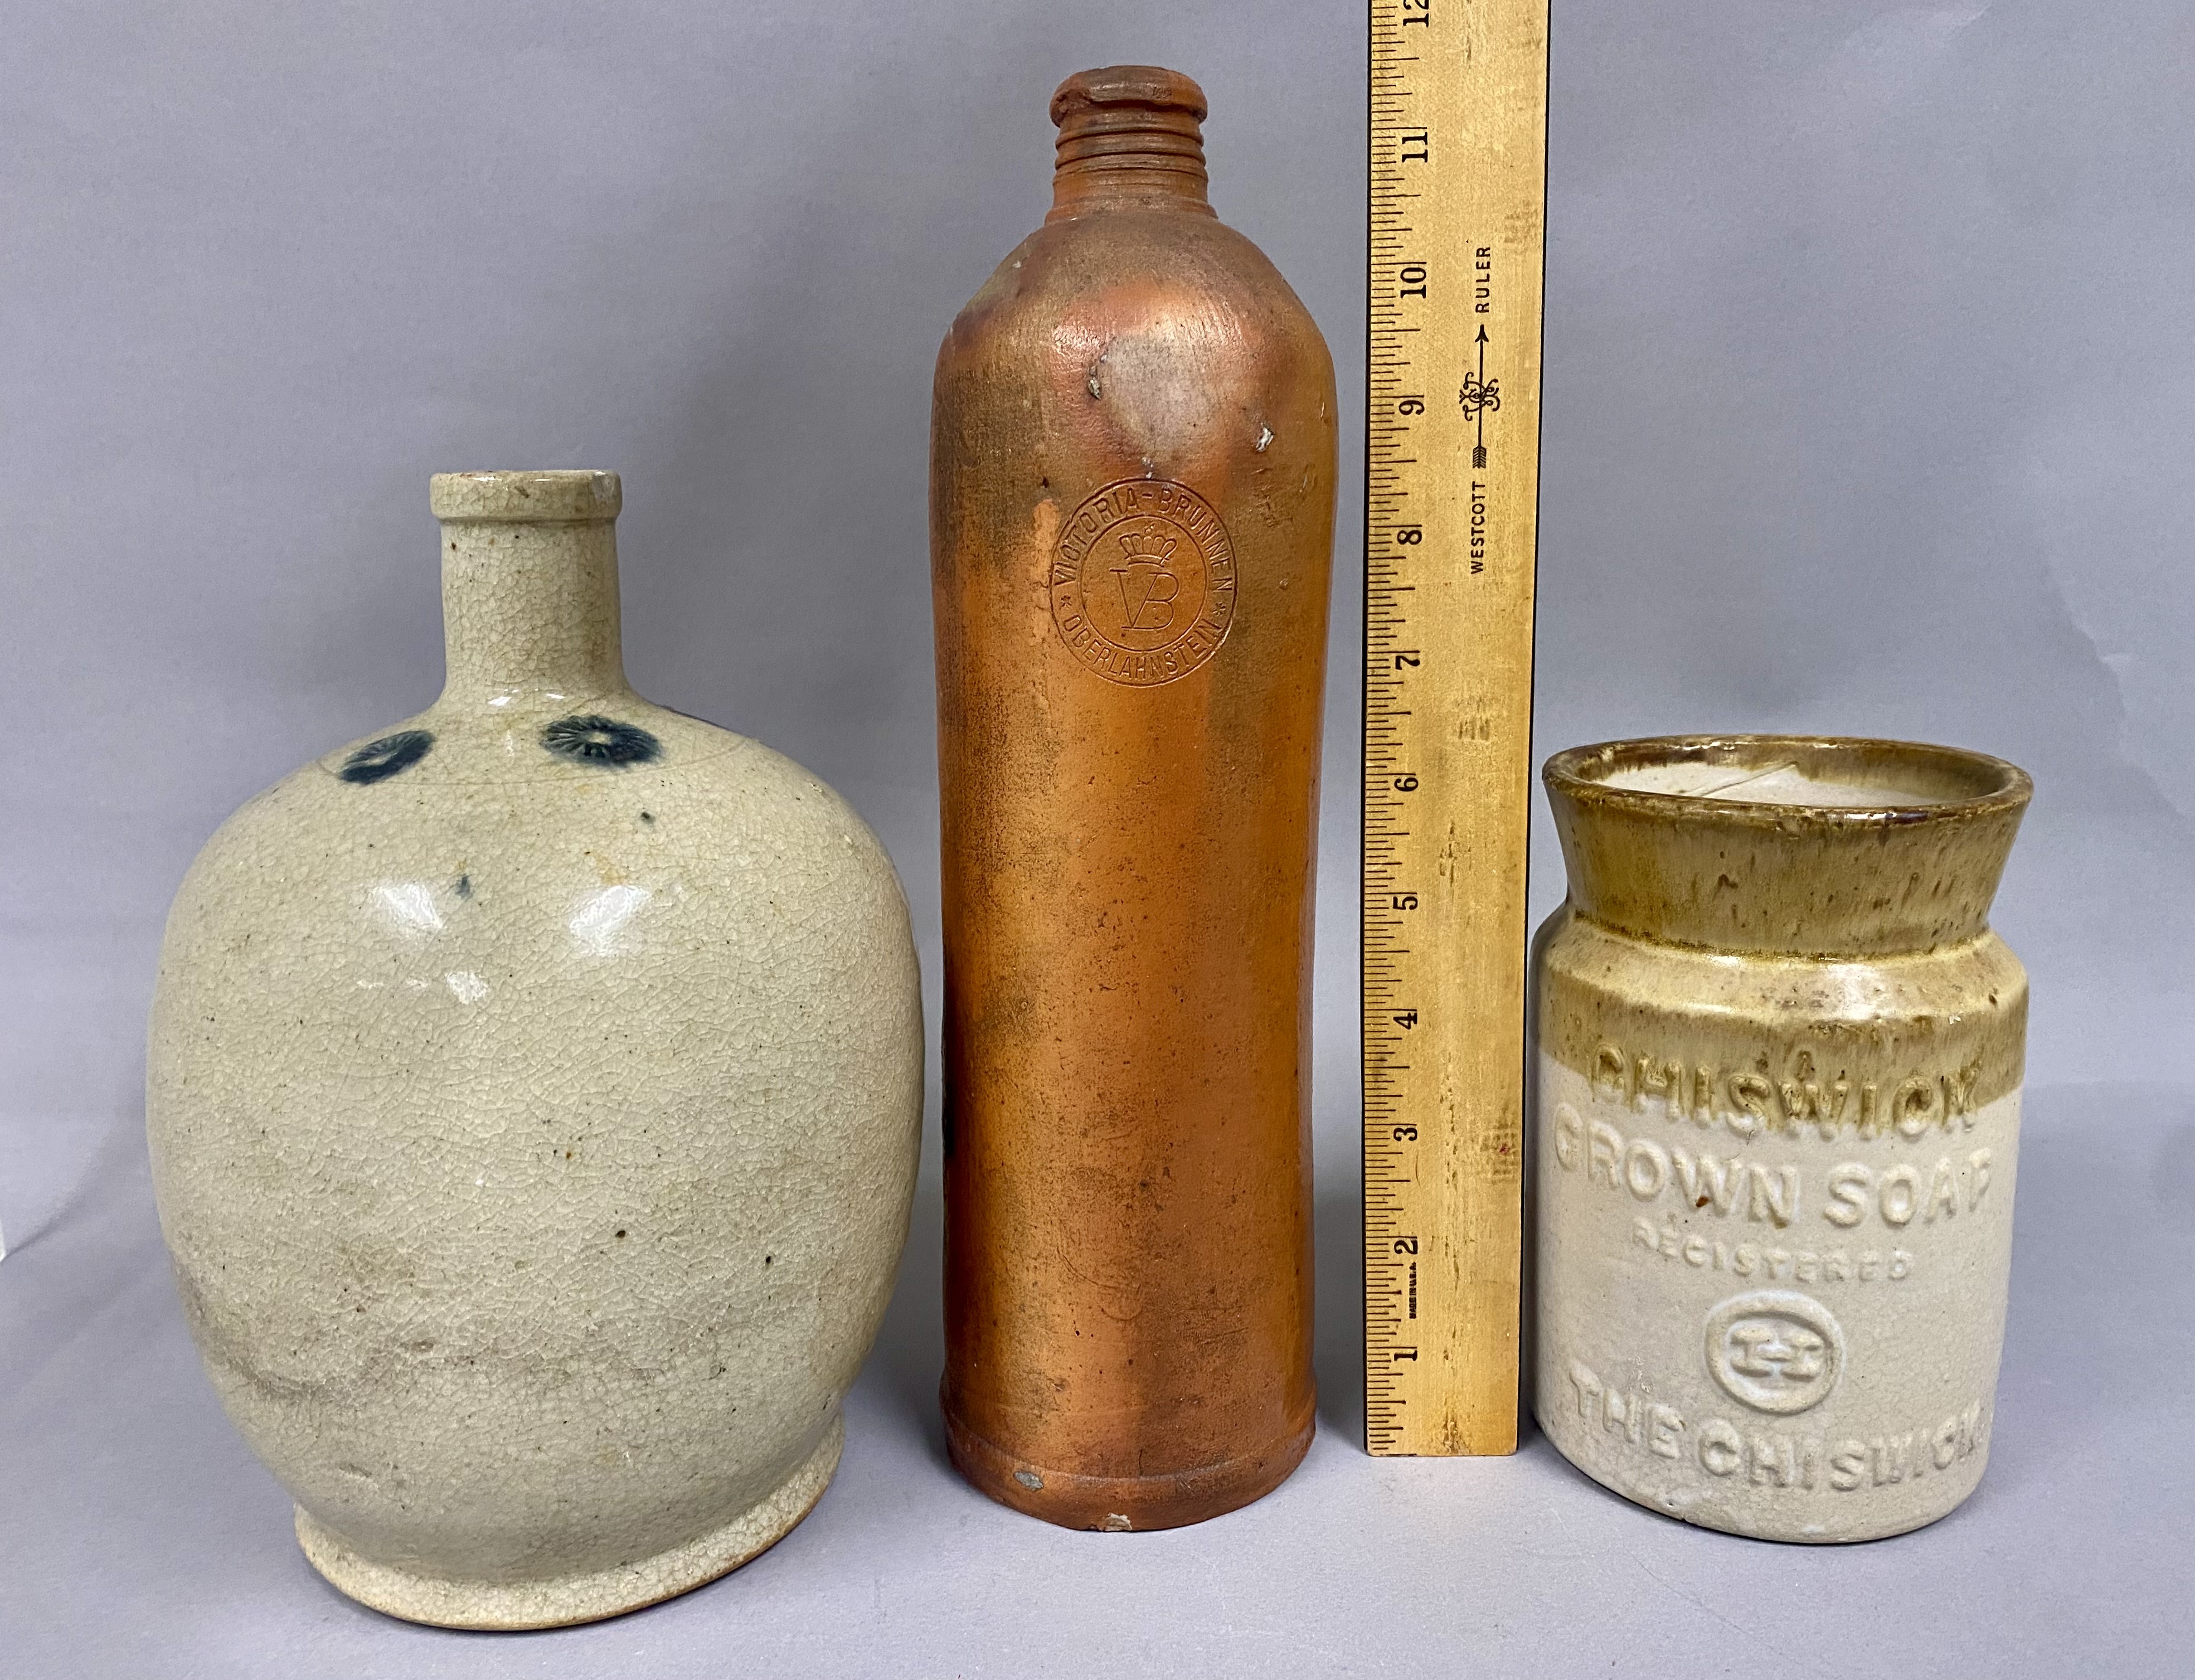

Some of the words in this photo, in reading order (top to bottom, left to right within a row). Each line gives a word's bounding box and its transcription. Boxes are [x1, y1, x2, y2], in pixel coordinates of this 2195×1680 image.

[1401, 132, 1428, 163] 11
[1400, 267, 1427, 299] 10
[1475, 247, 1491, 313] RULER
[1398, 400, 1425, 415] 9
[1054, 487, 1234, 593] VICTORIA-BRUNNEN
[1397, 530, 1422, 545] 8
[1470, 481, 1486, 574] WESTCOTT
[1061, 618, 1223, 682] OBERLAHNSTEIN
[1395, 655, 1421, 671] 7
[1394, 777, 1419, 792] 6
[1393, 896, 1418, 910] 5
[1393, 1012, 1417, 1030] 4
[1592, 1042, 1979, 1140] CHISWICK
[1393, 1127, 1418, 1142] 3
[1554, 1101, 1800, 1229] CROWN
[1824, 1147, 1992, 1227] SOAP
[1393, 1239, 1418, 1255] 2
[1631, 1216, 1913, 1283] REGISTERED
[1409, 1297, 1417, 1319] MADE
[1393, 1350, 1418, 1361] 1
[1568, 1360, 1684, 1460] THE
